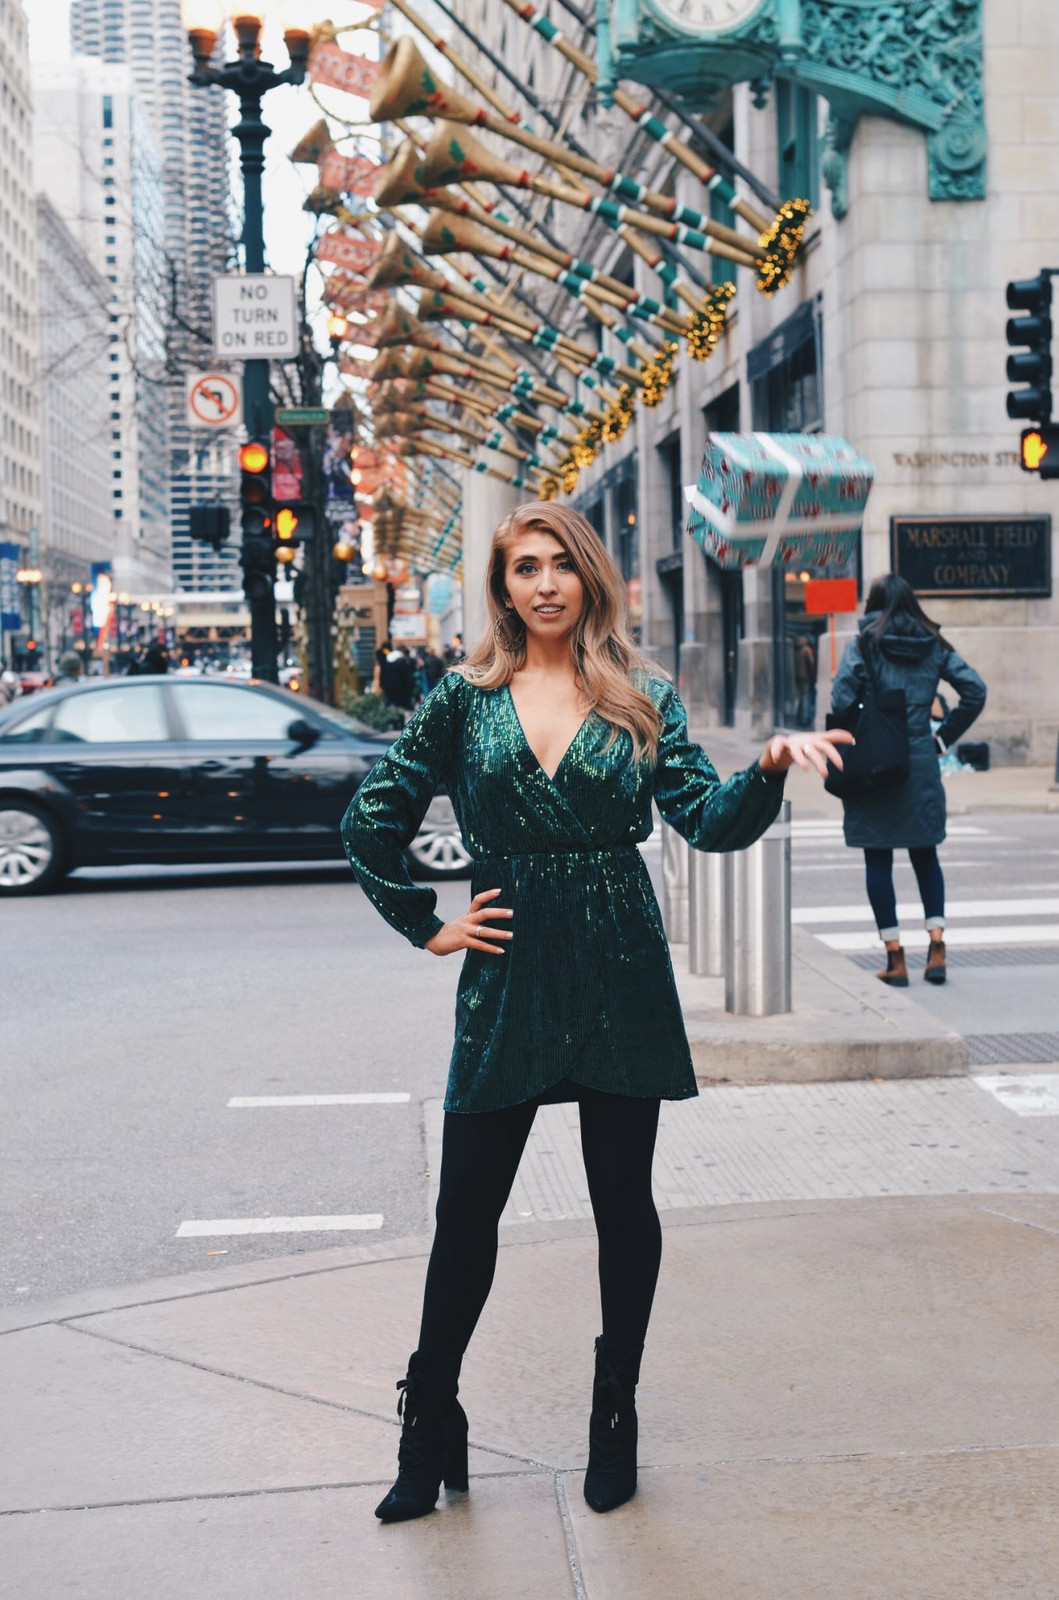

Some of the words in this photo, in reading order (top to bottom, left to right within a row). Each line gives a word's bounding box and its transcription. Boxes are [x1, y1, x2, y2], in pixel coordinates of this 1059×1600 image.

[240, 284, 268, 300] NO
[232, 307, 279, 324] TURN
[222, 331, 246, 347] ON
[254, 330, 289, 347] RED
[907, 526, 987, 548] MARSHALL
[994, 525, 1037, 547] FIELD
[956, 549, 988, 562] AND
[934, 564, 1011, 585] COMPANY
